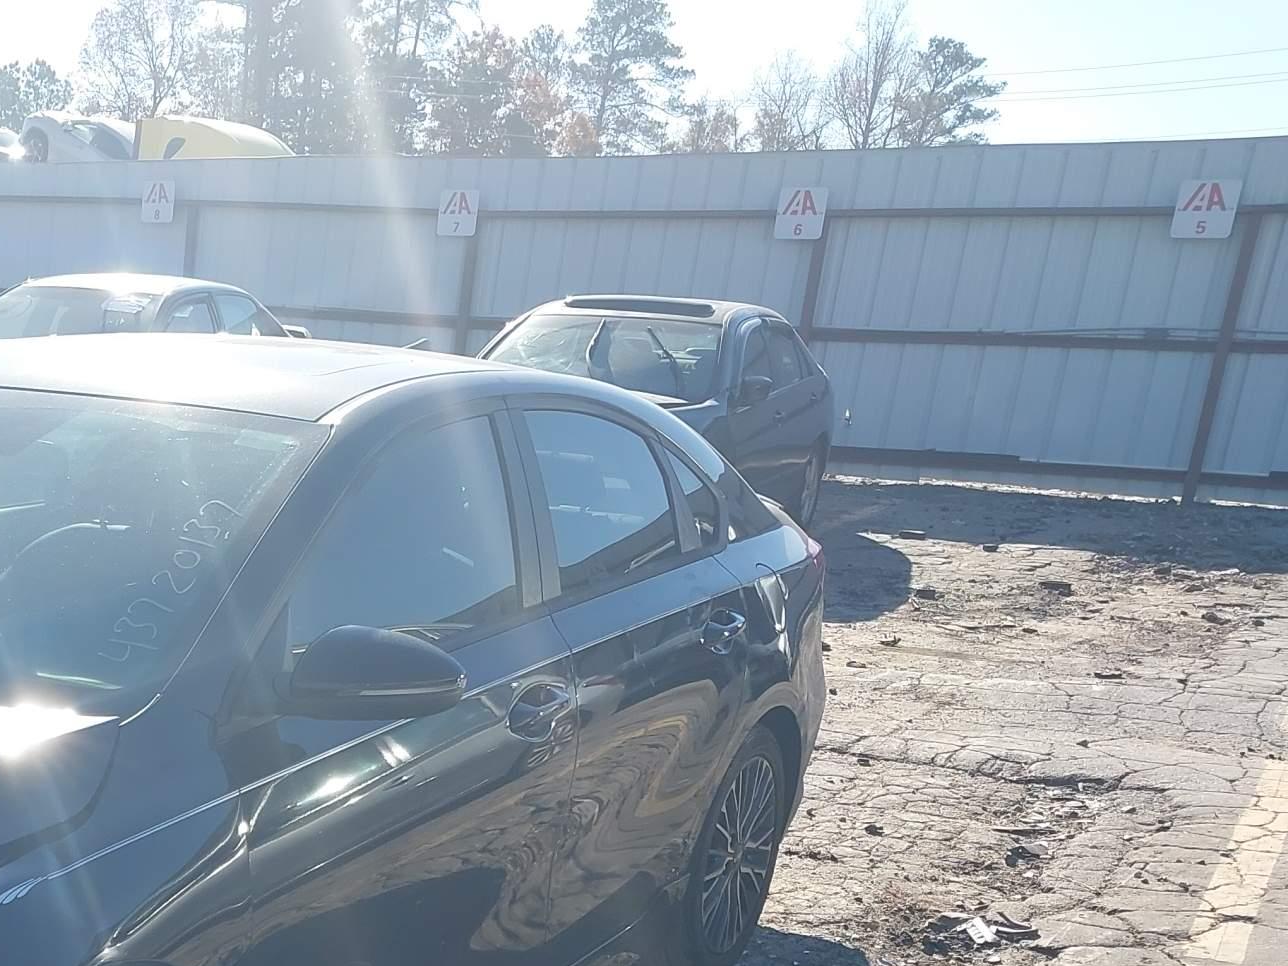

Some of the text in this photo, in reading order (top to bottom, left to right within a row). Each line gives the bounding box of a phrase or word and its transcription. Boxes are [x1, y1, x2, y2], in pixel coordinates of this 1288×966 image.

[153, 209, 160, 220] 8
[453, 222, 460, 233] 7
[793, 224, 803, 236] 6
[1195, 220, 1206, 234] 5
